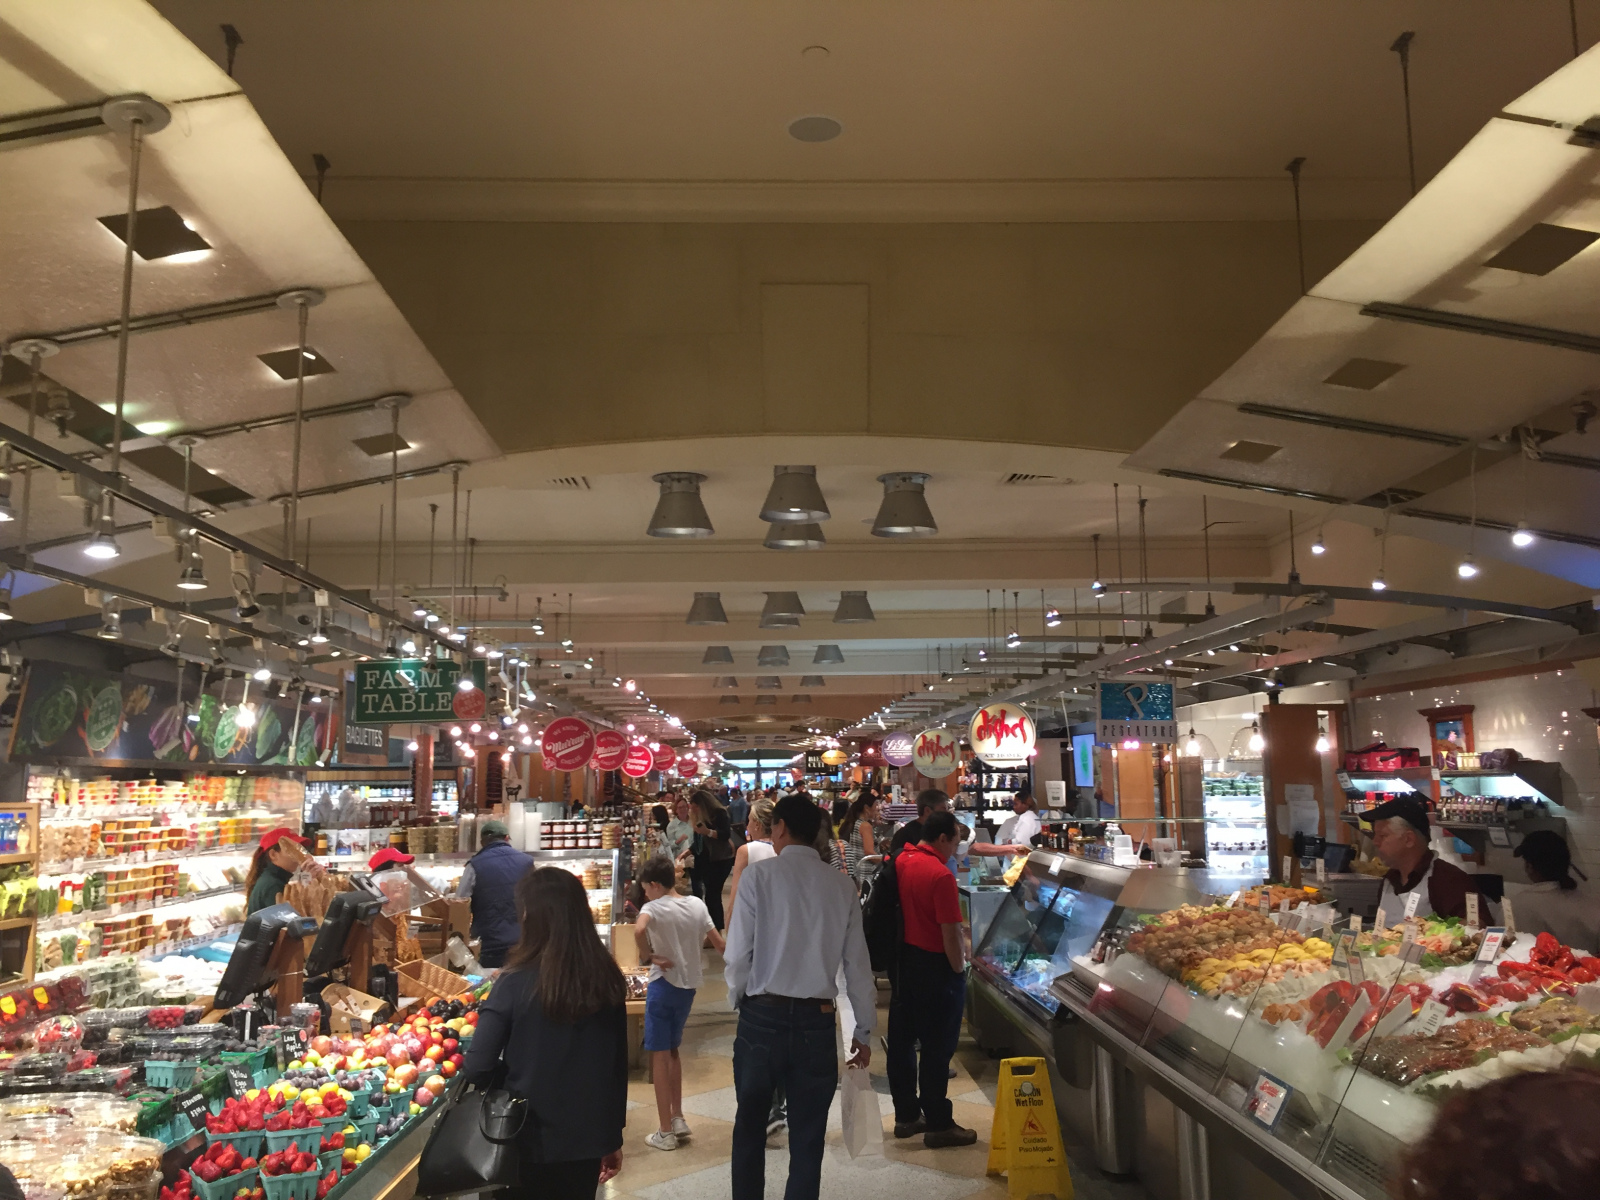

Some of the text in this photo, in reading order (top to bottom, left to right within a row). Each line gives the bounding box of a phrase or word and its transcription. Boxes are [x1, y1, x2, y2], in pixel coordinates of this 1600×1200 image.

[362, 692, 452, 713] TABLE
[345, 725, 383, 747] BAGUETTES
[976, 709, 1028, 748] dishes
[1102, 724, 1174, 738] PESCATORE
[545, 731, 591, 754] Murray's
[917, 734, 955, 764] dishes
[1014, 1088, 1041, 1097] CAON
[1015, 1098, 1044, 1107] Wet Floor
[1032, 1145, 1054, 1154] Mojado
